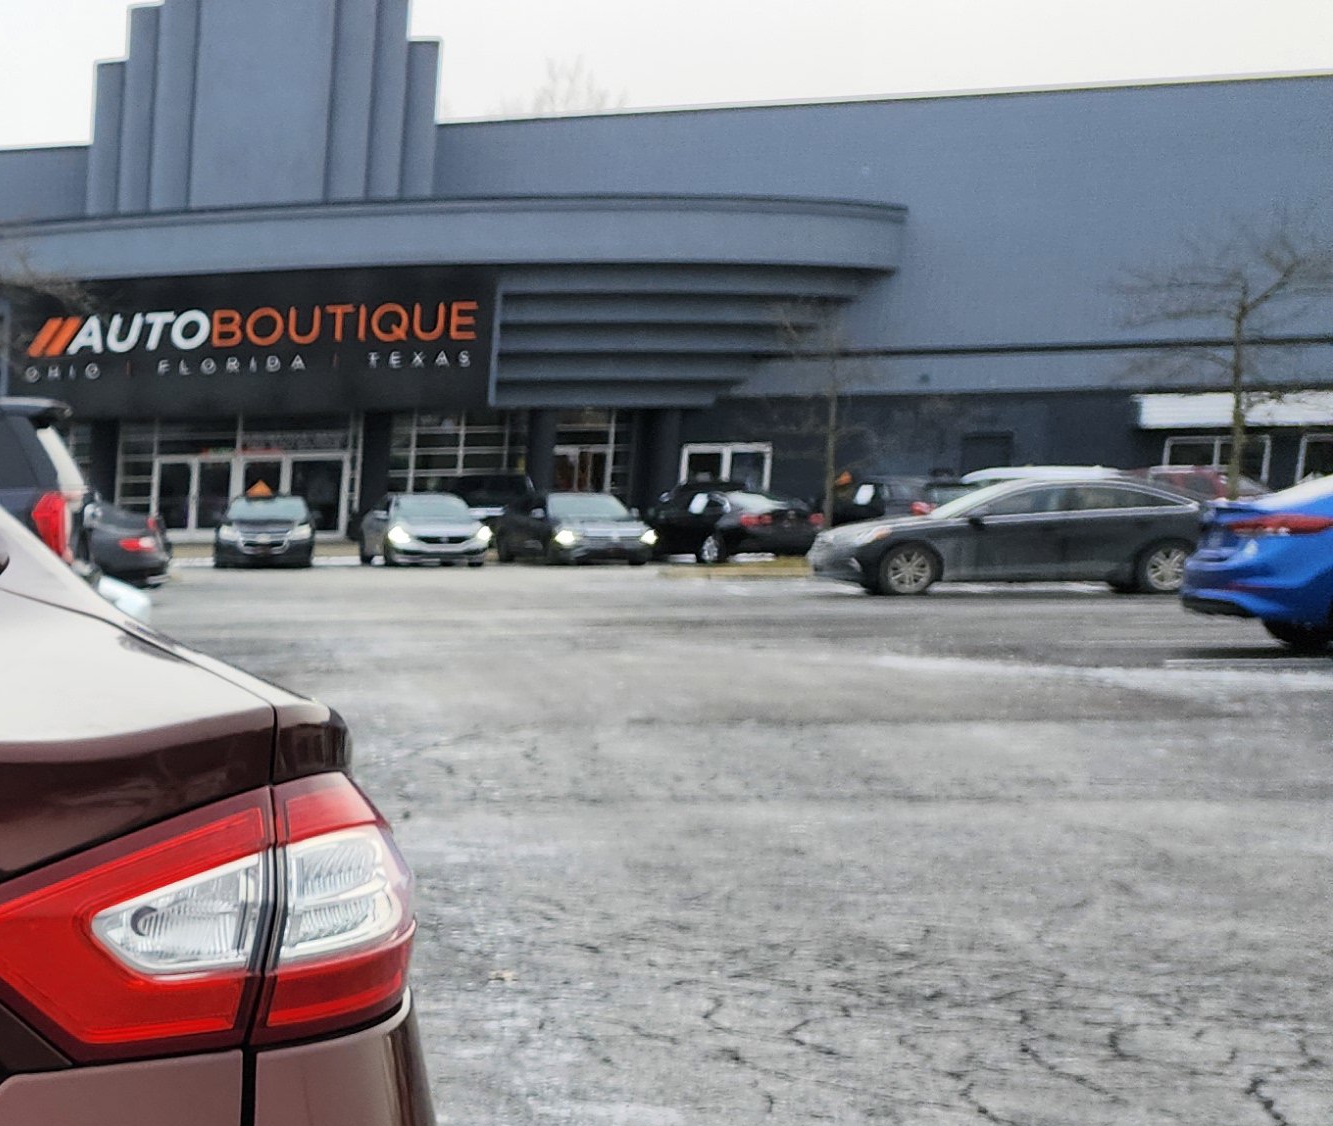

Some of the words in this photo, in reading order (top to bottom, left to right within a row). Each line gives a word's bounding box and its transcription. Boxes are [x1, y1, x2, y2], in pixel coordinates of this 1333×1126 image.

[25, 362, 102, 382] OHIO
[158, 352, 307, 375] FLORIDA
[368, 348, 472, 369] TEXAS
